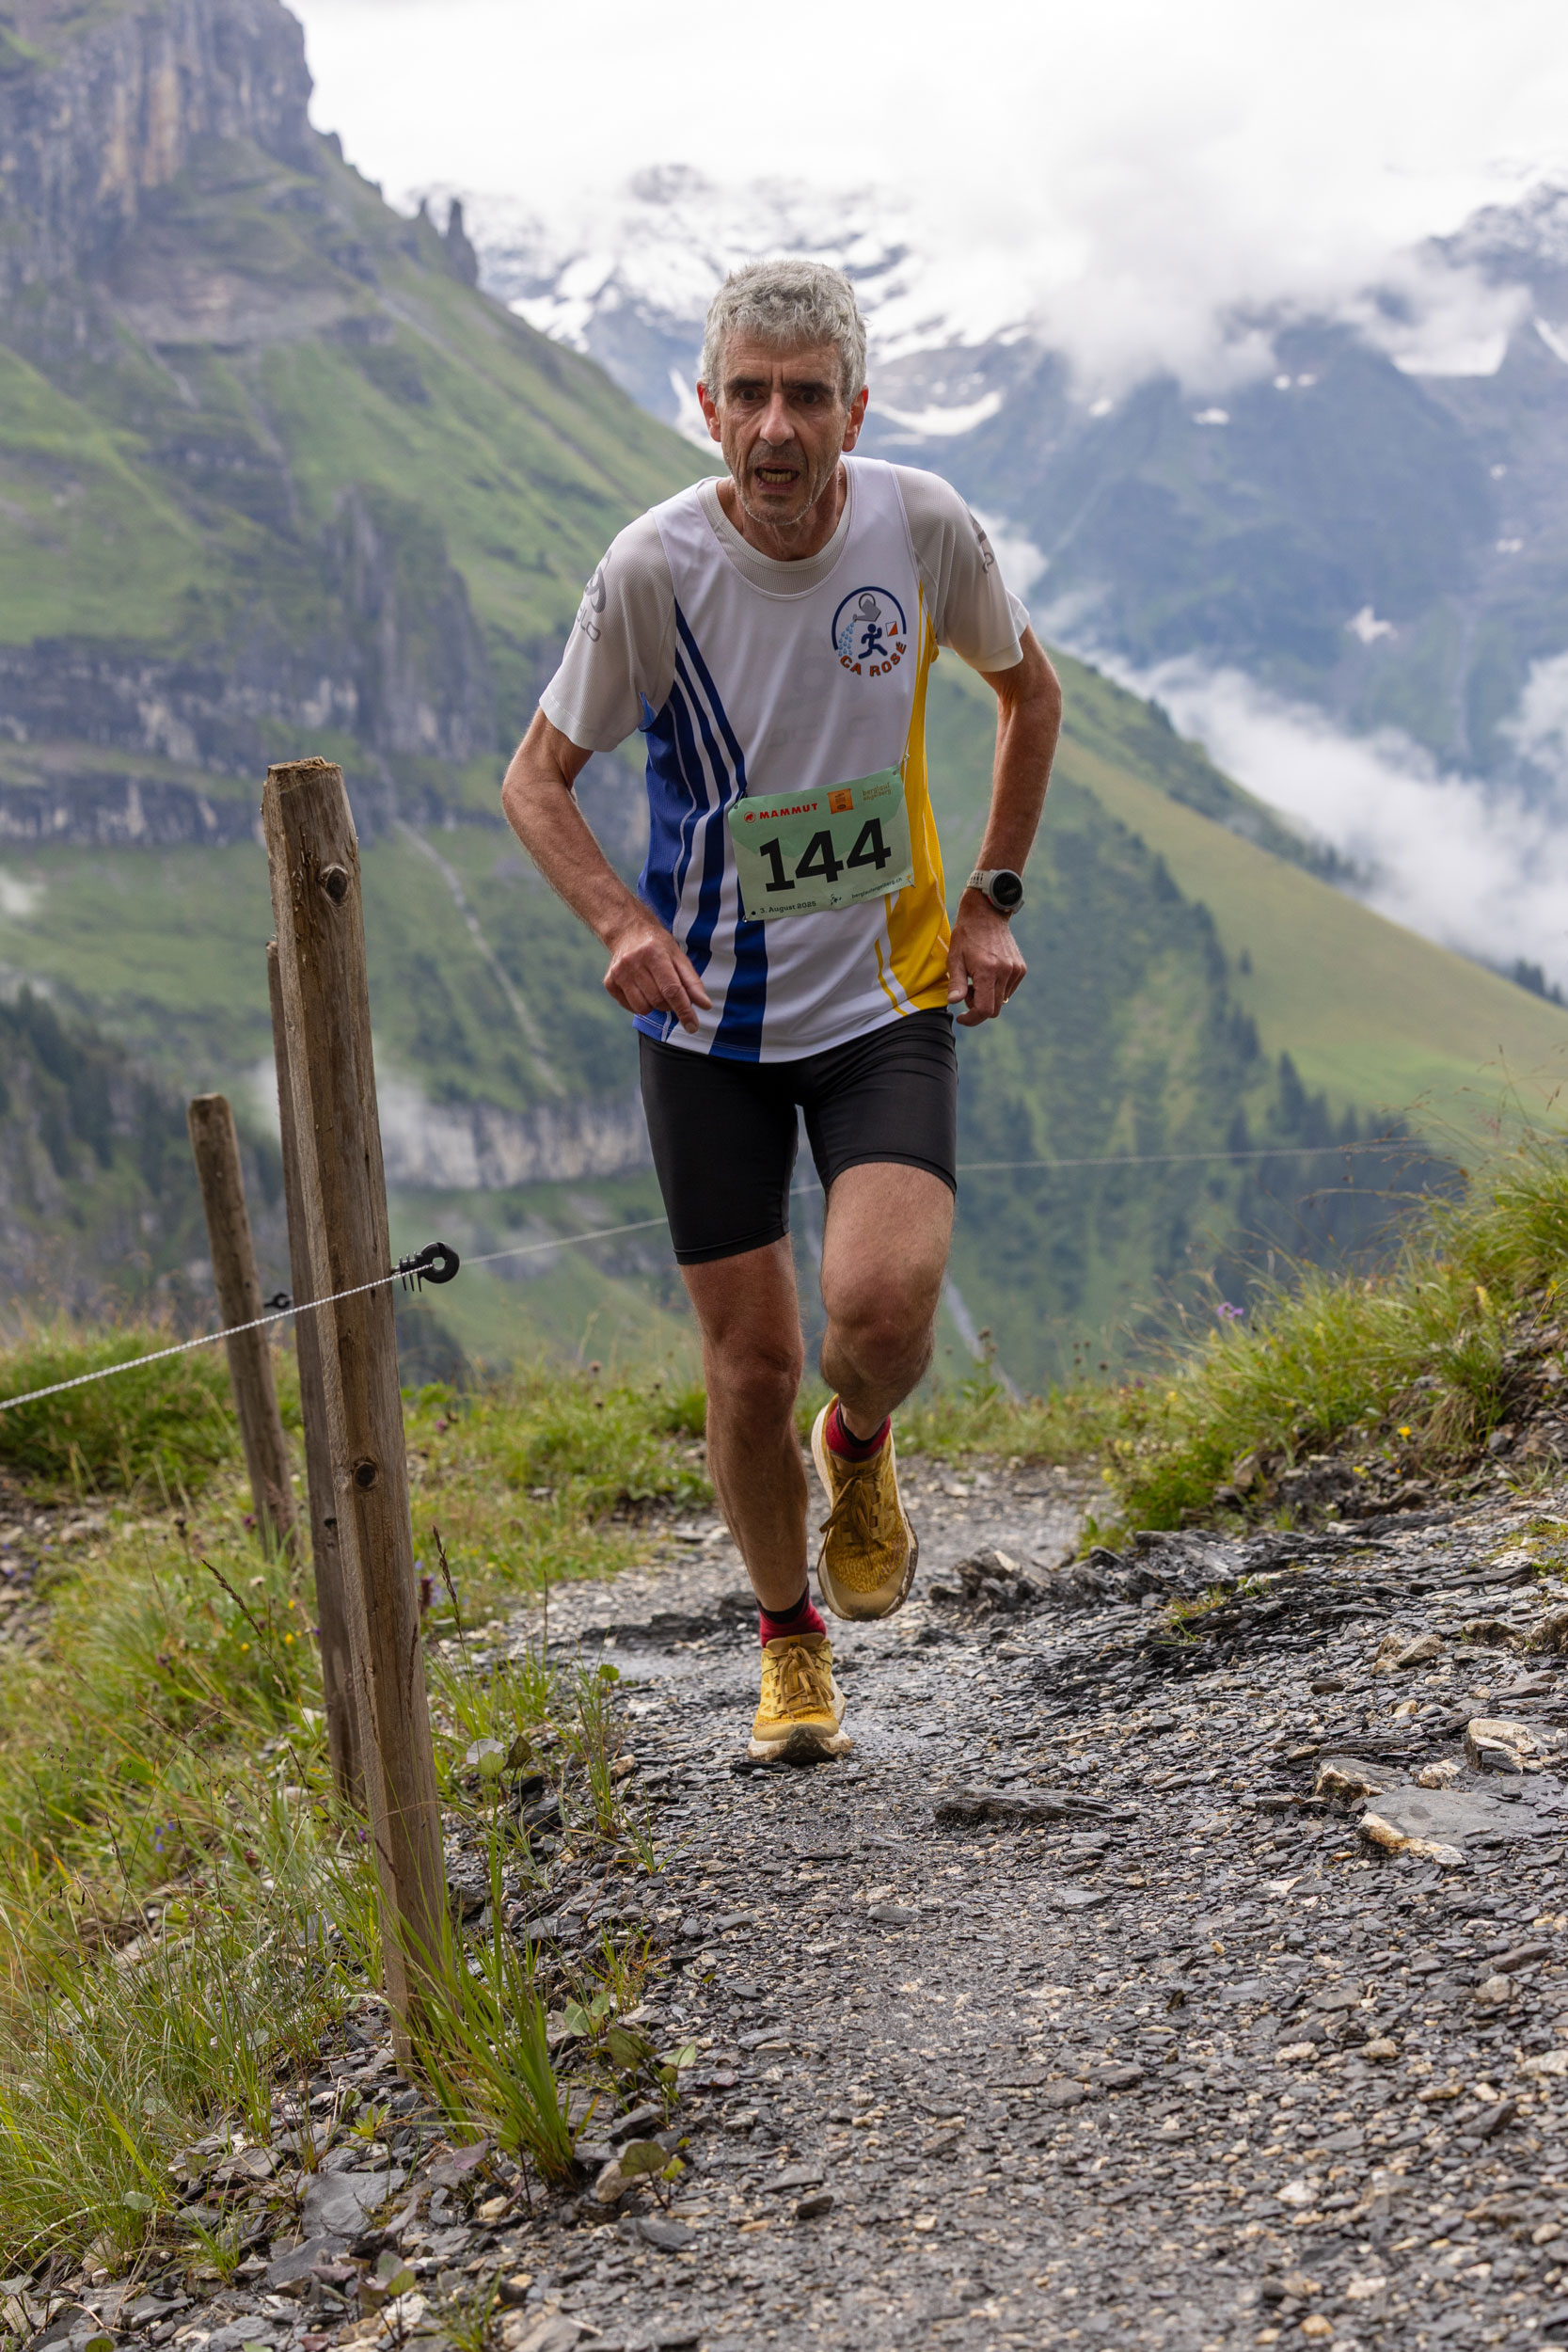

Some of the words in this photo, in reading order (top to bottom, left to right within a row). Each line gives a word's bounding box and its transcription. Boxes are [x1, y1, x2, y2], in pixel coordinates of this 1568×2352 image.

[840, 655, 862, 675] CA
[869, 641, 907, 677] ROSE
[862, 782, 890, 796] berglauf
[759, 803, 818, 819] MAMMUT
[759, 818, 892, 893] 144
[768, 903, 796, 914] August
[797, 900, 817, 910] 2025
